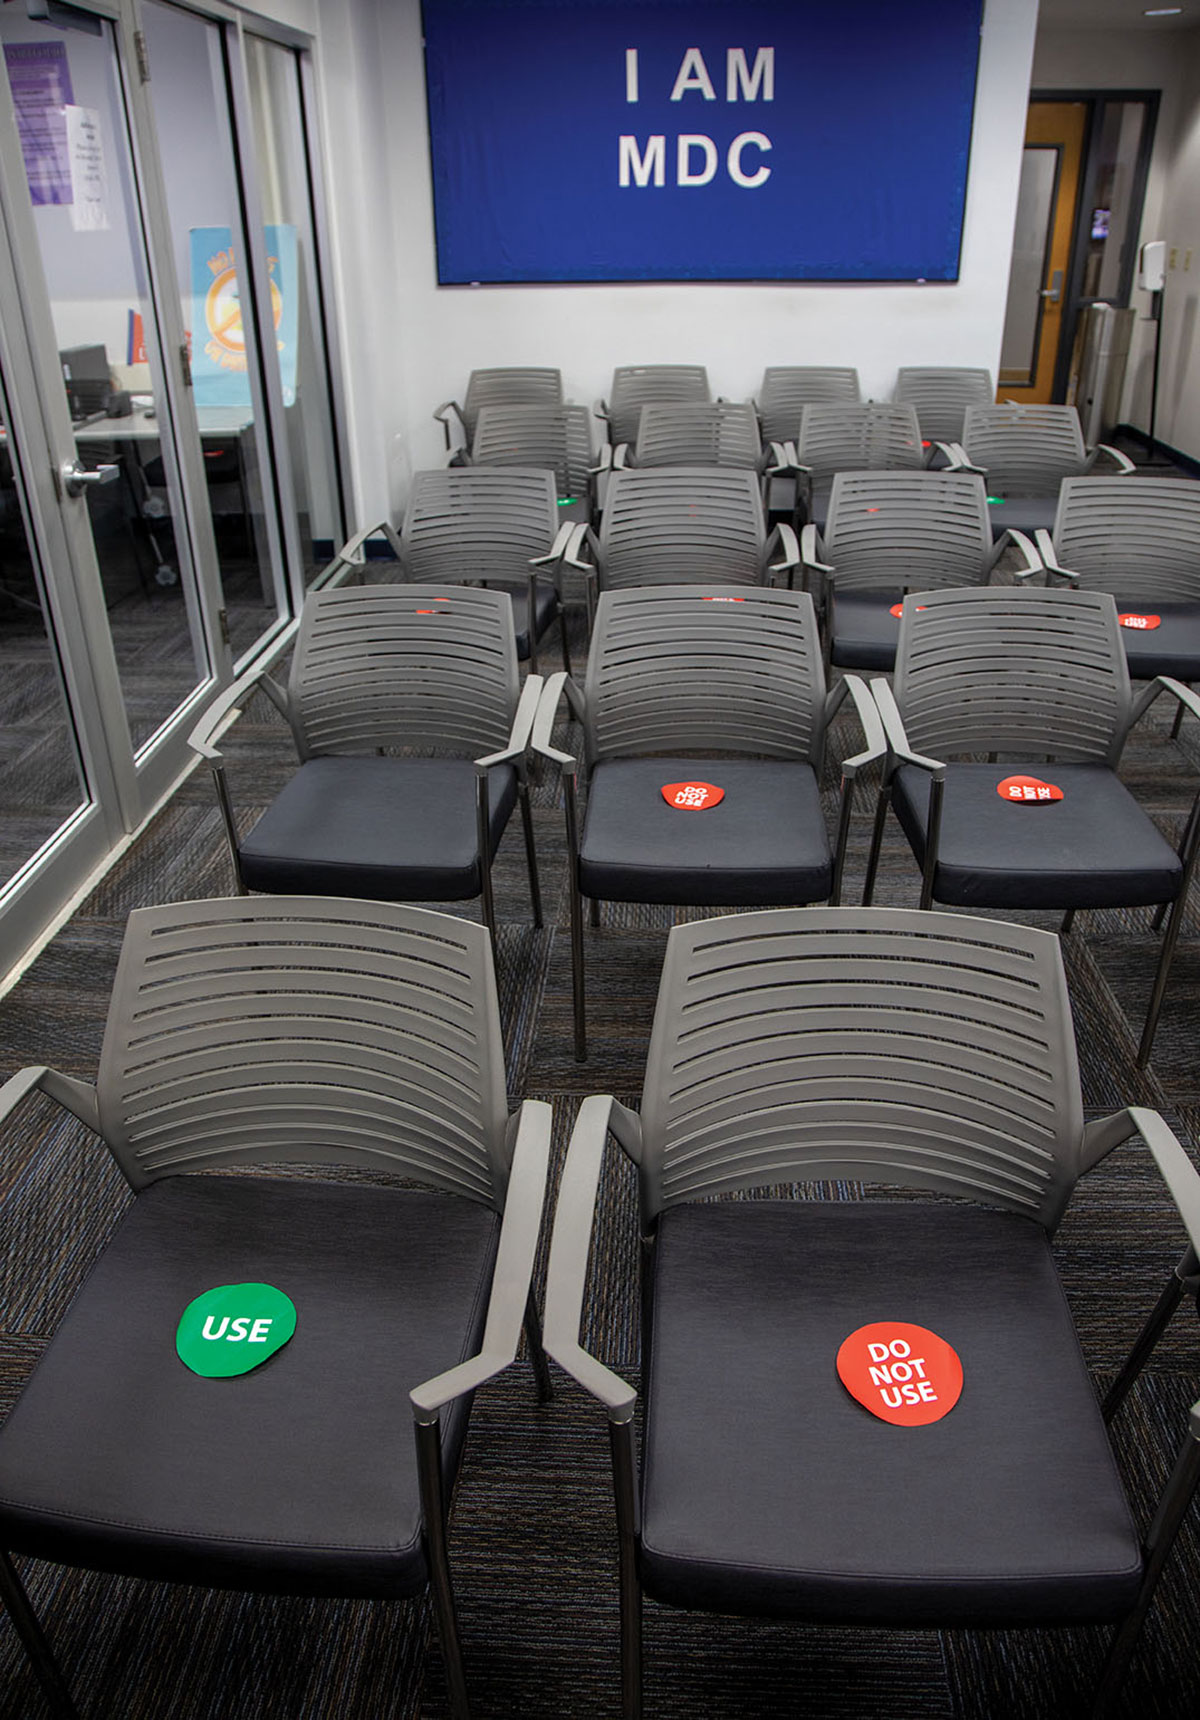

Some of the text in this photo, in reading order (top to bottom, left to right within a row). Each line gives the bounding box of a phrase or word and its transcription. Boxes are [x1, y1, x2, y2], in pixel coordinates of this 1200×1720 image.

[625, 47, 775, 102] I AM
[619, 131, 773, 188] MDC
[674, 797, 704, 807] USE
[676, 791, 709, 800] NOT
[684, 786, 708, 794] DO
[201, 1315, 273, 1343] USE
[867, 1339, 911, 1363] DO
[868, 1358, 926, 1386] NOT
[879, 1380, 939, 1408] USE
